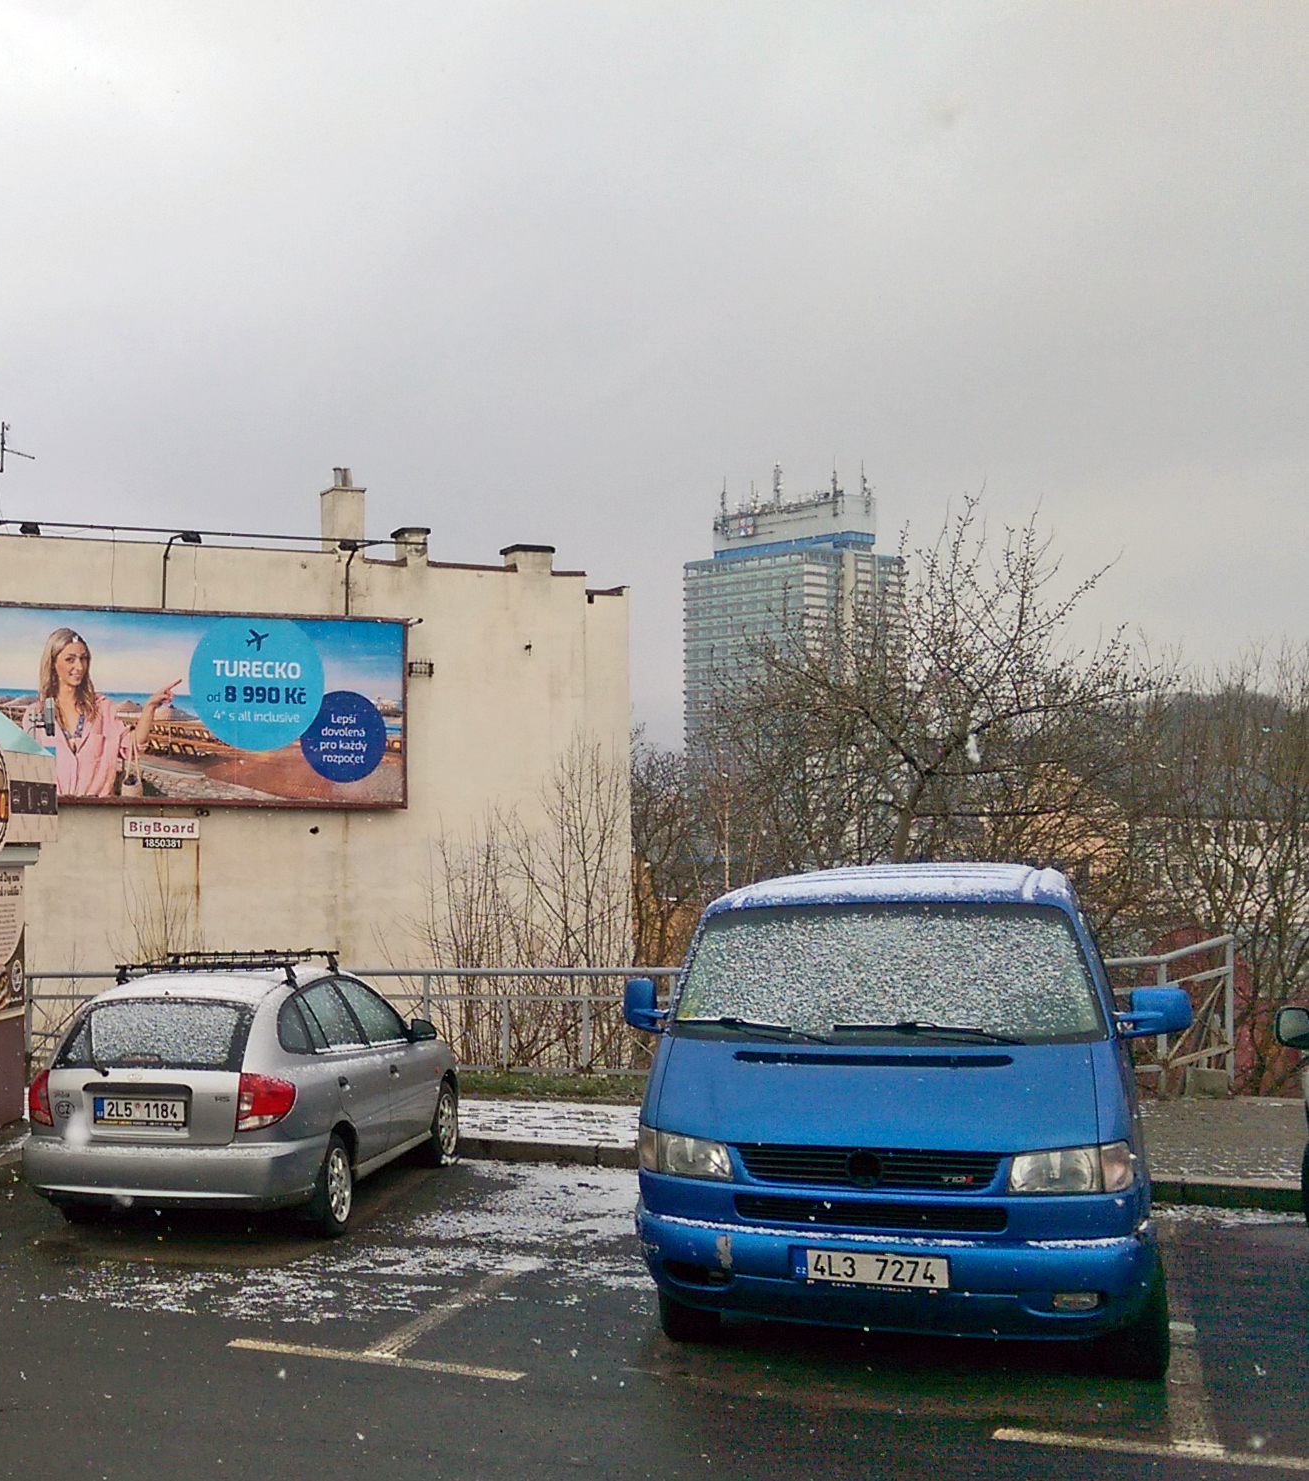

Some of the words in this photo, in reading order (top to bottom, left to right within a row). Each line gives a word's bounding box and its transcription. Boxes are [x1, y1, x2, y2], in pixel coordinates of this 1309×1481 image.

[212, 659, 302, 679] TURECKO
[207, 691, 221, 703] od
[224, 685, 237, 703] 8
[242, 686, 281, 704] 990
[284, 687, 307, 705] Kč
[228, 713, 235, 722] s
[238, 711, 251, 723] all
[253, 711, 300, 723] inclusive
[331, 712, 357, 726] Lepší
[321, 725, 366, 738] dovolená
[319, 740, 337, 752] pro
[338, 739, 368, 752] každý
[322, 753, 365, 765] rozpočet
[129, 821, 195, 835] BigBoard
[57, 1103, 71, 1115] CZ
[107, 1102, 132, 1118] 2L5
[144, 1102, 177, 1119] 1184
[795, 1266, 808, 1275] CZ
[813, 1254, 856, 1278] 4L3
[875, 1258, 936, 1284] 7274
